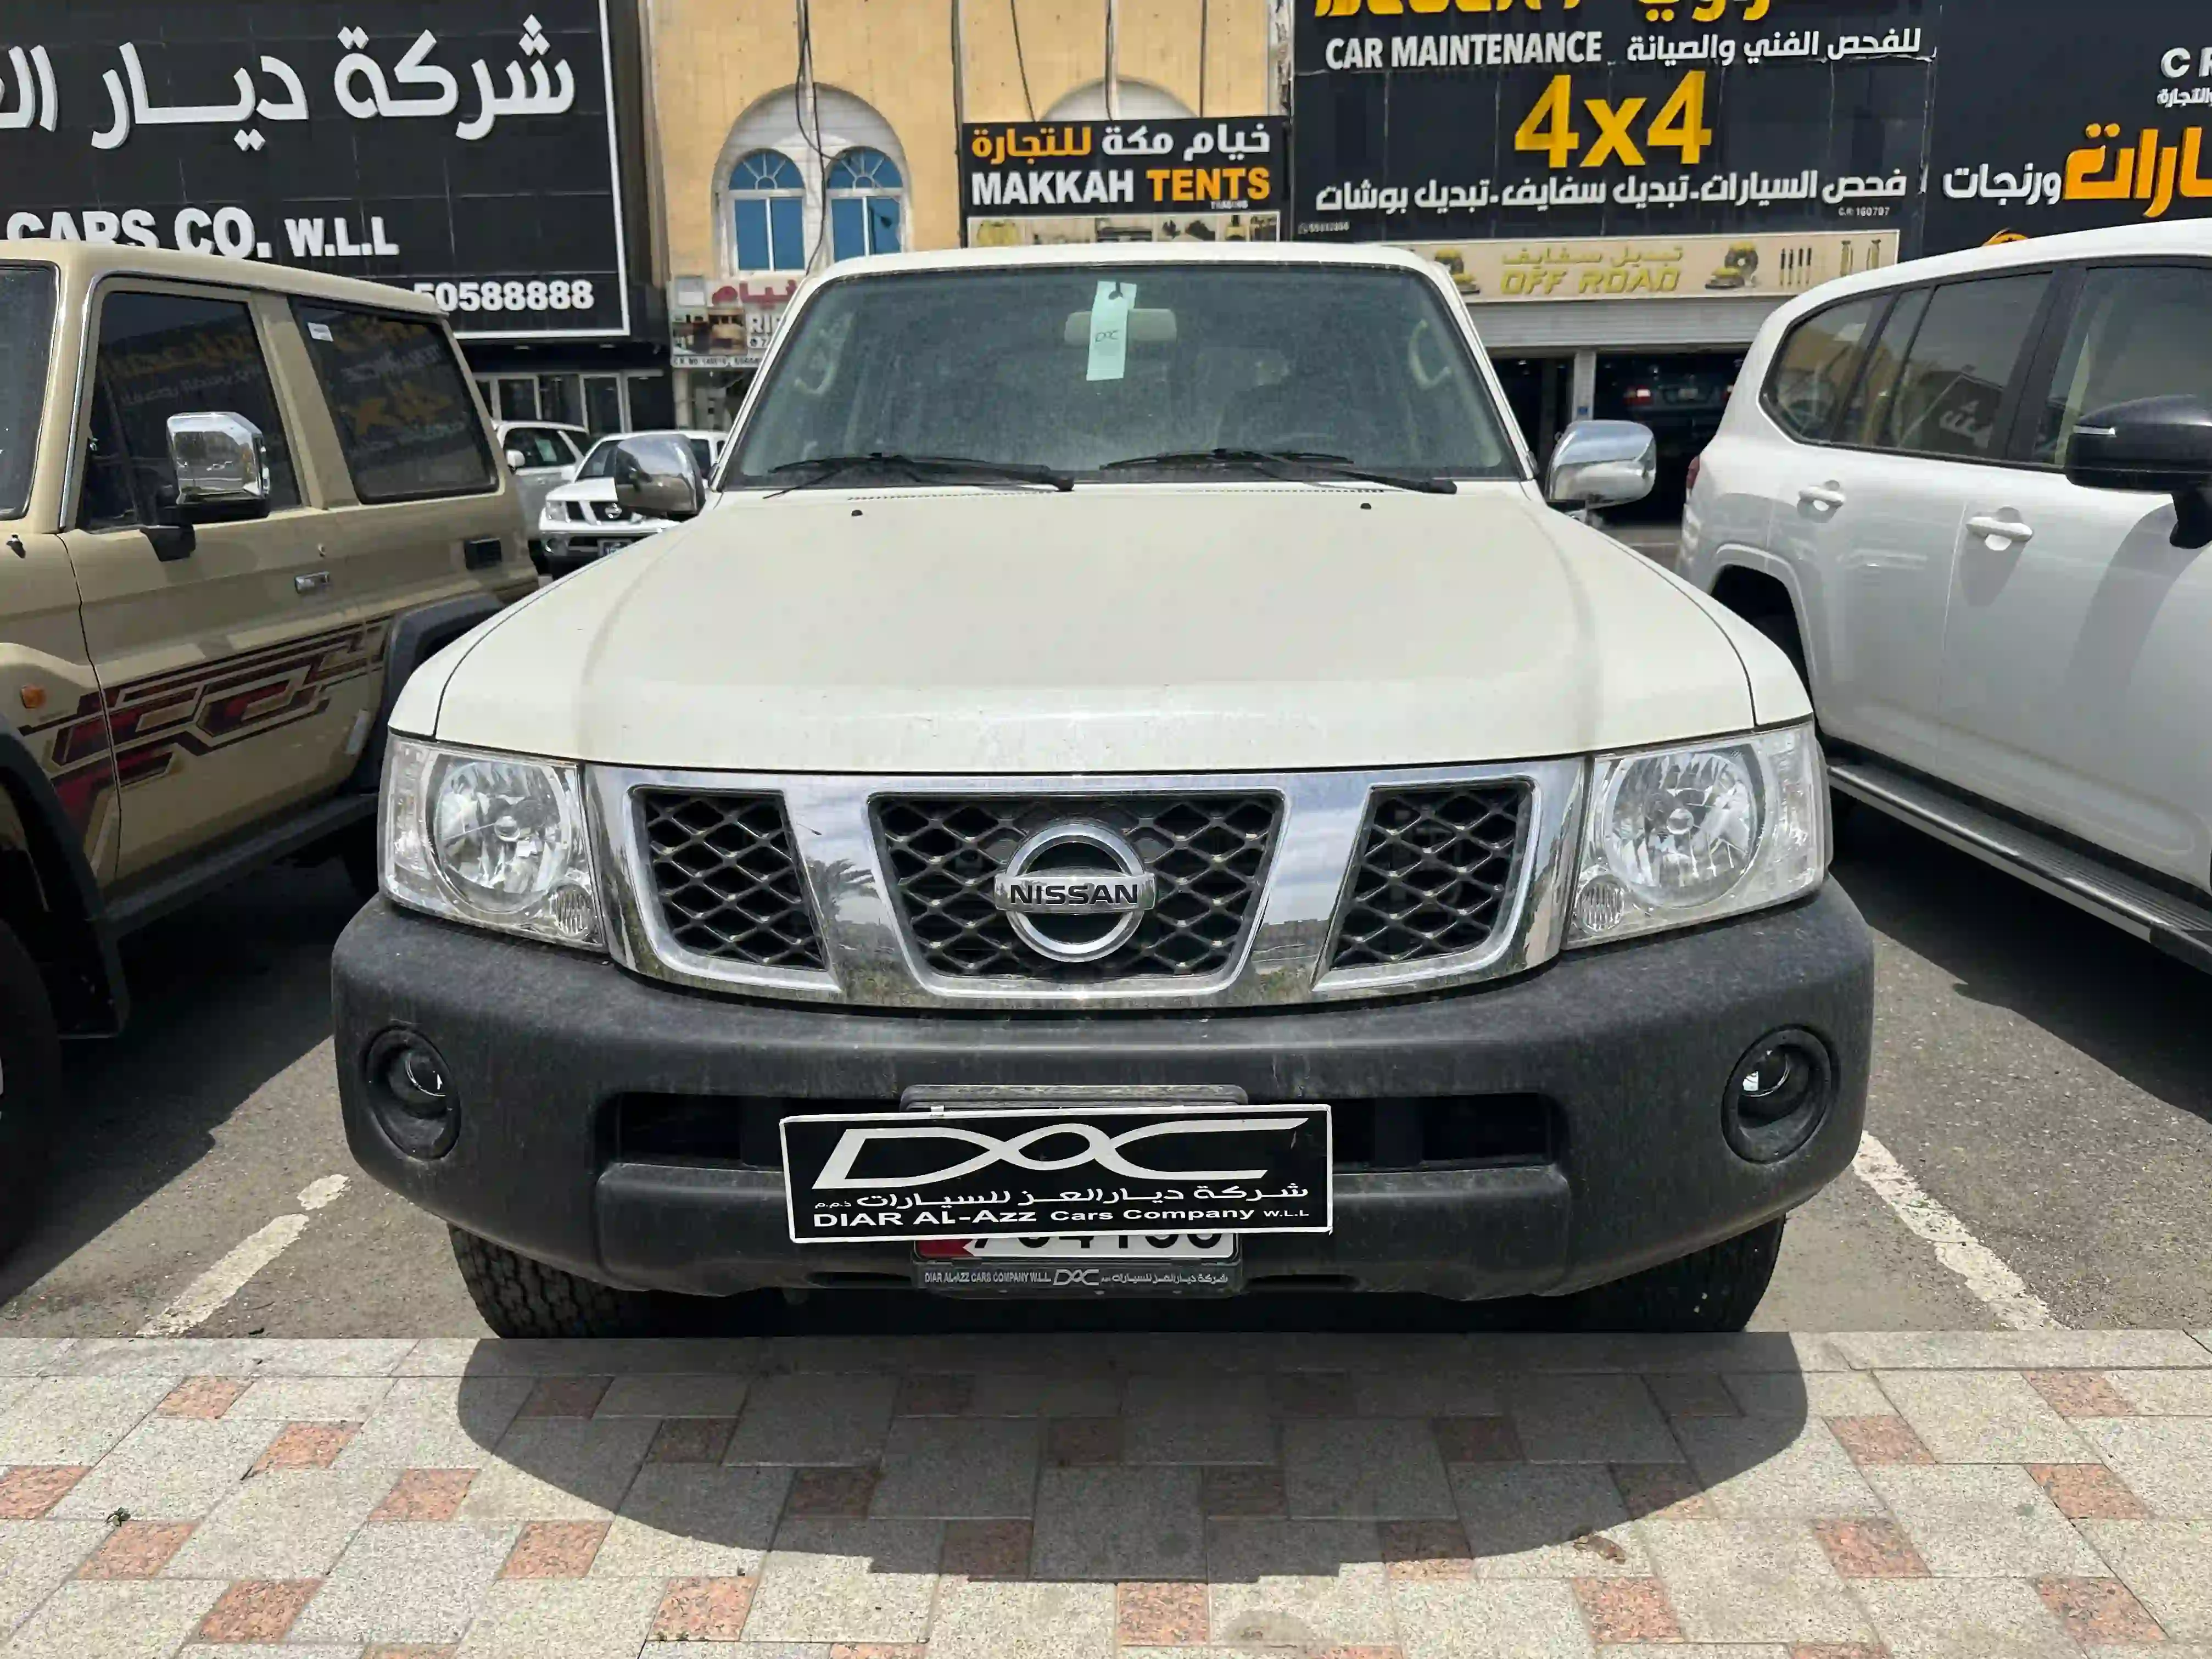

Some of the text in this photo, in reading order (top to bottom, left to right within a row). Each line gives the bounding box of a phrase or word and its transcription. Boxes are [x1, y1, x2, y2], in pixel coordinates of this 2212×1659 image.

[1325, 31, 1603, 70] CAR MAINTENANCE
[1627, 27, 1921, 66] للفحص الفني والصيانة
[91, 41, 310, 152] ديار
[333, 14, 575, 141] شركة
[1514, 70, 1712, 169] 4x4
[972, 122, 1271, 165] خيام مكة للتجارة
[971, 167, 1271, 205] MAKKAH TENTS
[1316, 179, 1409, 215] بوشات
[1822, 168, 1907, 204] فحص
[1942, 163, 2063, 206] ورنجات
[174, 207, 273, 259] CO.
[284, 216, 400, 257] W.L.L
[1500, 267, 1681, 295] OFF ROAD
[1010, 884, 1138, 905] NISSAN
[857, 1190, 1010, 1209] للسيارات
[1193, 1182, 1309, 1202] شركة
[813, 1212, 903, 1227] DIAR
[1050, 1210, 1114, 1221] Cars
[1123, 1209, 1255, 1221] Company
[925, 1272, 942, 1283] DIAR
[971, 1272, 991, 1282] CARS
[993, 1272, 1029, 1283] COMPANY
